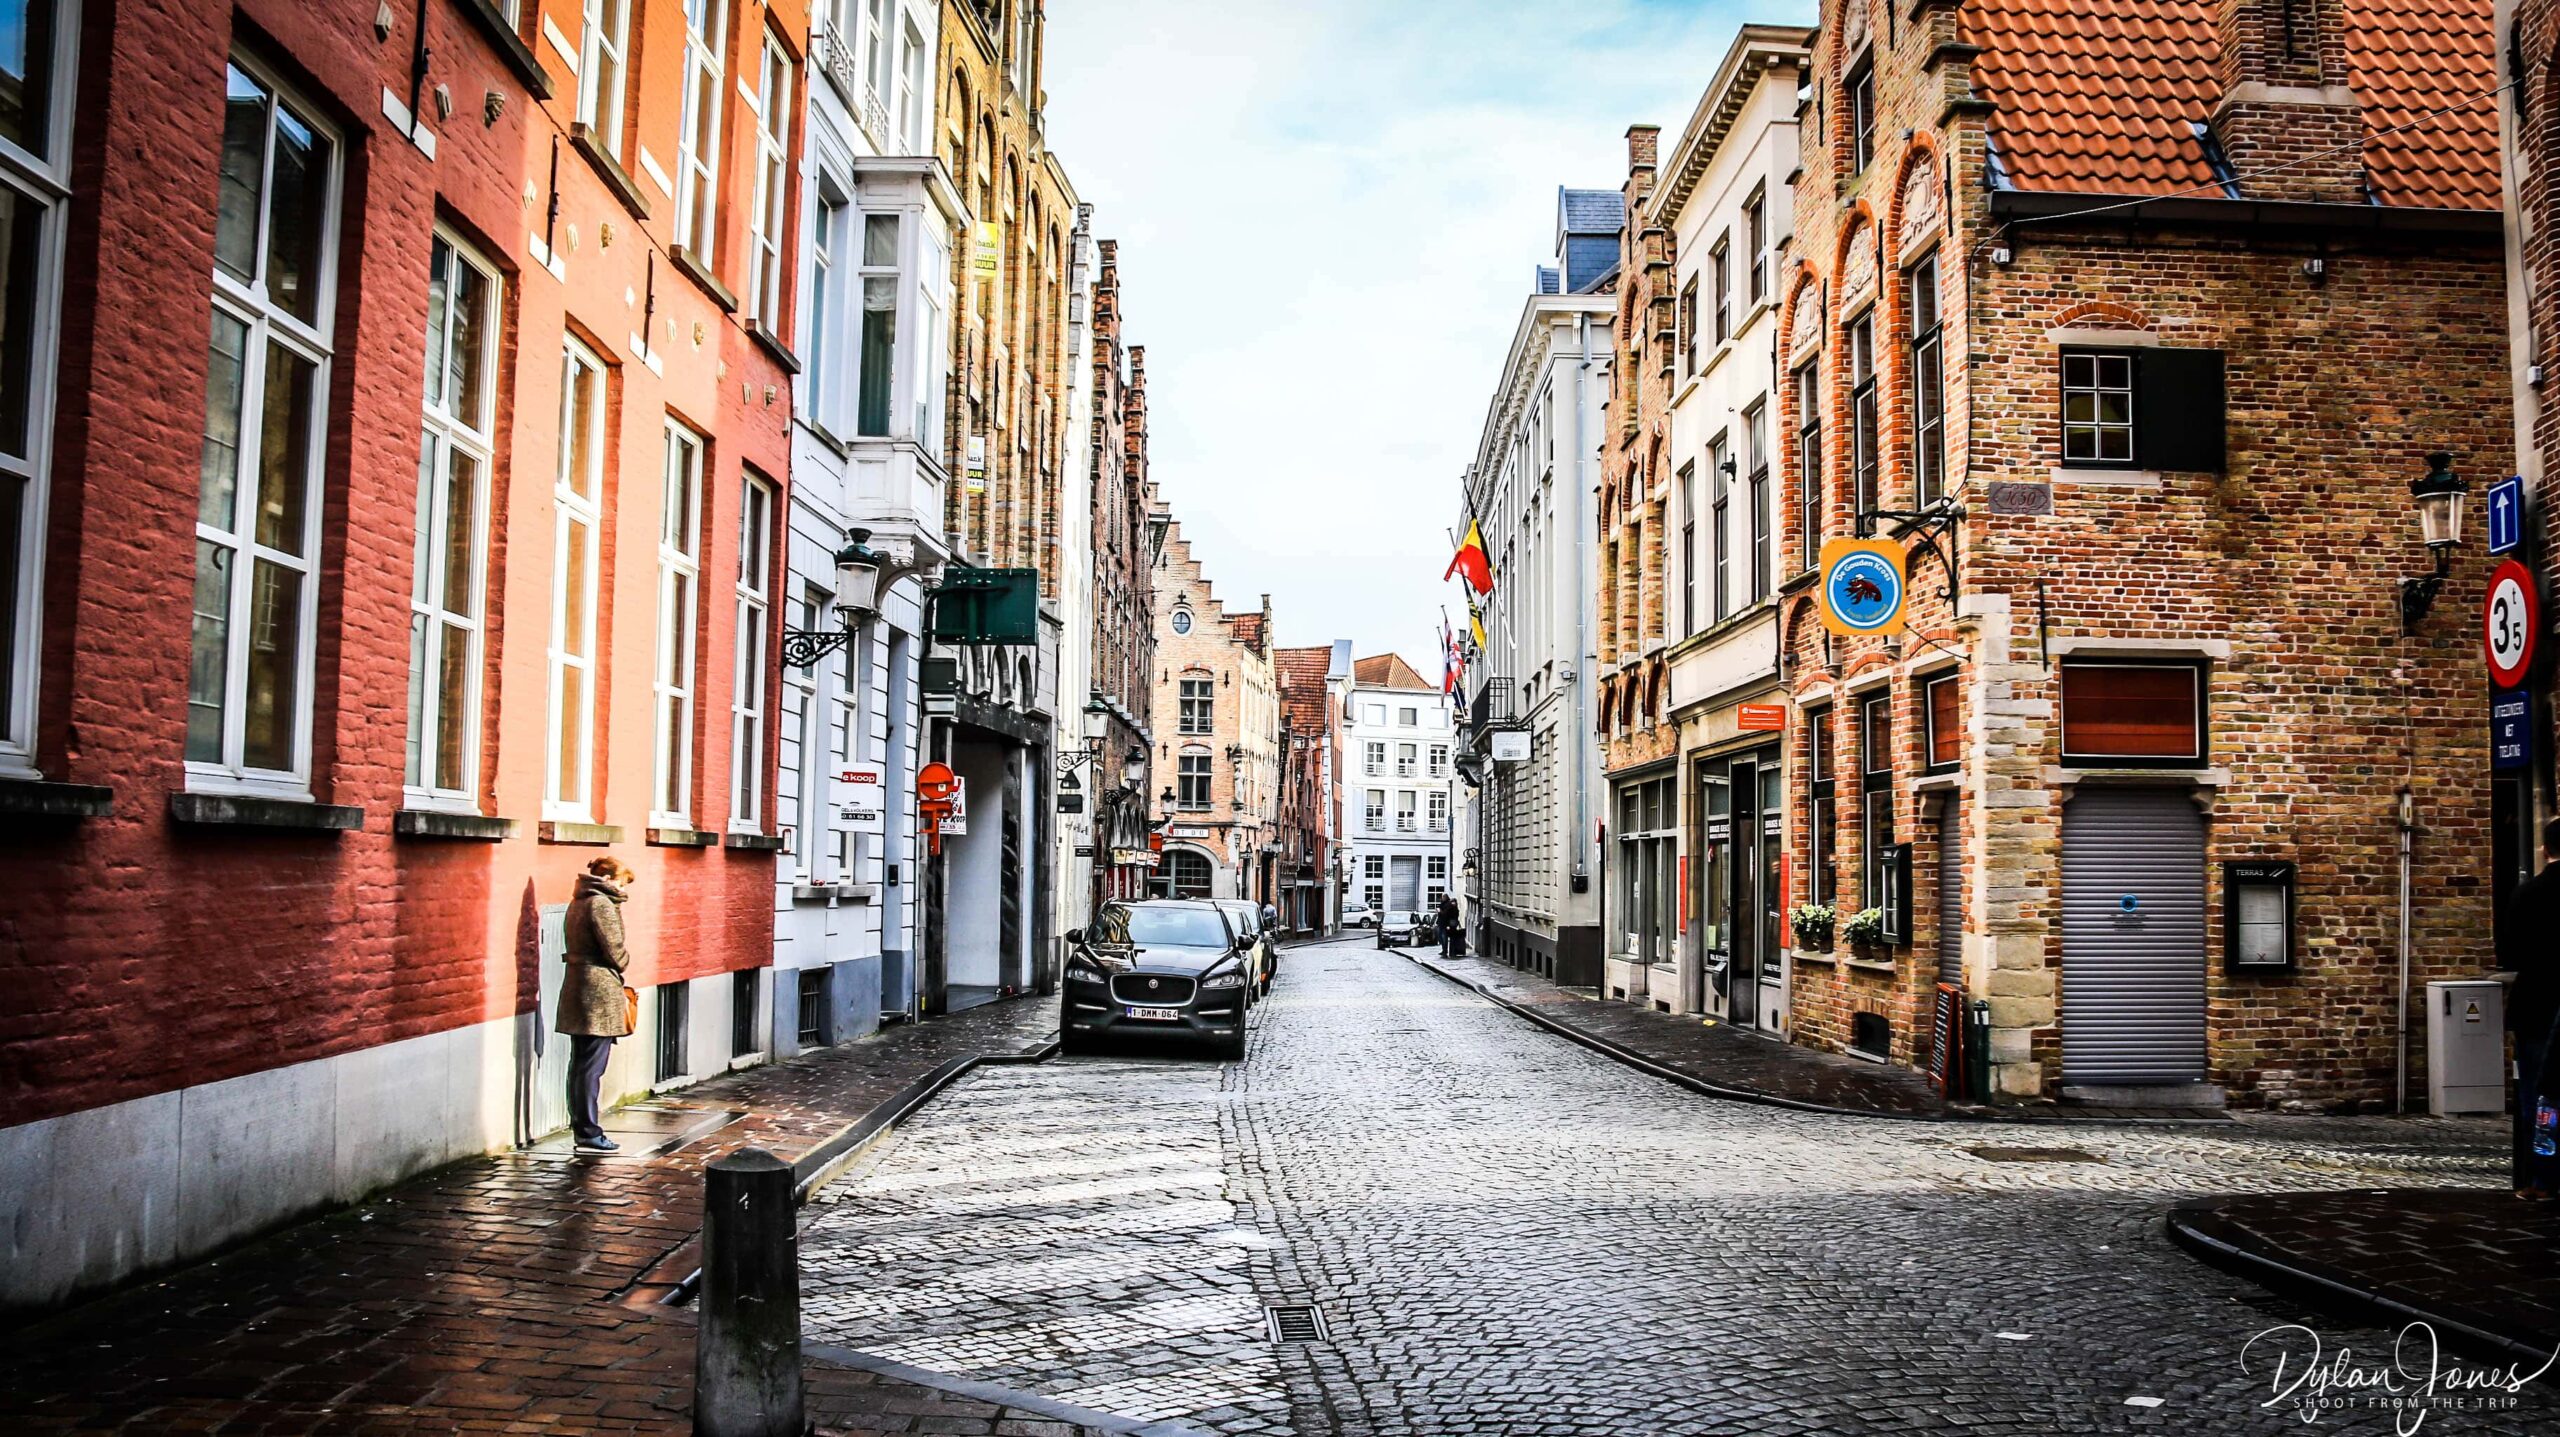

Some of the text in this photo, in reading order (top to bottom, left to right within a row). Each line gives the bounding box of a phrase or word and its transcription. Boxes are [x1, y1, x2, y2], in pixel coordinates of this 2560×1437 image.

[2007, 490, 2036, 506] 1650
[1836, 572, 1846, 582] De
[1844, 559, 1873, 571] Gouden
[850, 773, 875, 783] koop
